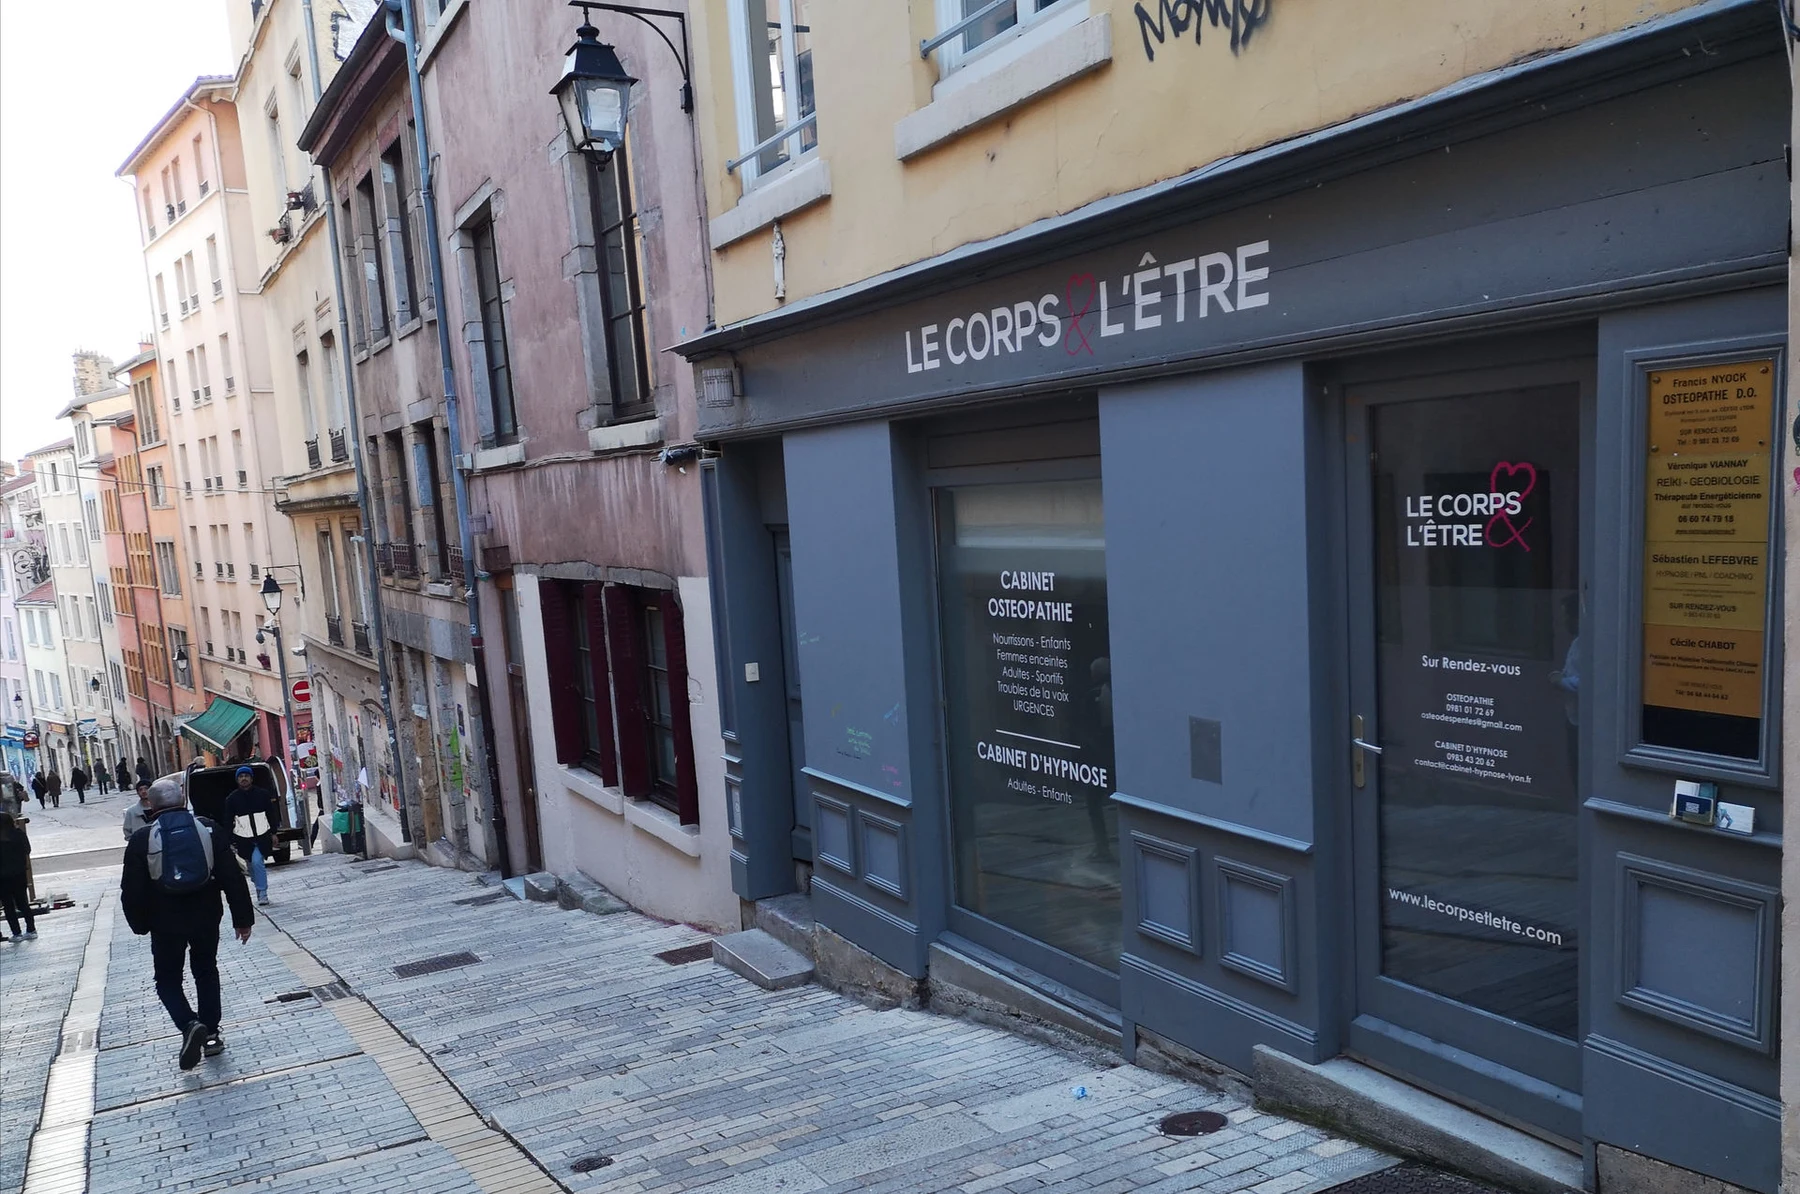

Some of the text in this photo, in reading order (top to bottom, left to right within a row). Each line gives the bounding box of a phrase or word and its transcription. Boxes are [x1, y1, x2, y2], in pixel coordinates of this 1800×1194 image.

[905, 323, 940, 374] LE
[945, 293, 1062, 365] CORPS
[1099, 239, 1270, 339] L'ÊTRE
[1672, 372, 1747, 388] Francis NYOCK
[1663, 387, 1757, 405] OSTEOPATHE D.O.
[1667, 459, 1748, 471] Véronique VIANNAY
[1689, 475, 1760, 487] GEOBIOLOGIE
[1406, 491, 1521, 517] LE CORPS
[1654, 491, 1762, 502] Thérapeute Energéticienne
[1678, 515, 1688, 523] 06
[1700, 515, 1710, 523] 74
[1407, 519, 1483, 546] L'ÊTRE
[1652, 554, 1759, 566] Sébastien LEFEBVRE
[1000, 570, 1055, 591] CABINET
[988, 598, 1073, 622] OSTEOPATHIE
[1669, 602, 1683, 610] SUR
[993, 633, 1034, 647] Nourrissons
[1040, 635, 1071, 650] Enfants
[1670, 637, 1737, 650] Cécile CHABOT
[997, 648, 1068, 669] Femmes enceintes
[1421, 654, 1521, 676] Sur Rendez-vous
[1002, 666, 1030, 681] Adultes
[1035, 670, 1064, 685] Sportifs
[997, 680, 1070, 702] Troubles de la voix
[1446, 693, 1494, 706] OSTEOPATHIE
[1013, 699, 1055, 718] URGENCES
[1446, 703, 1495, 717] 0981 01 72 69
[1434, 740, 1509, 759] CABINET D'HYPNOSE
[977, 741, 1107, 788] CABINET D'HYPNOSE
[1446, 752, 1496, 768] 0983 43 20 62
[1007, 778, 1036, 795] Adultes
[1042, 785, 1073, 804] Enfants
[1389, 888, 1562, 946] www.lecorpsetletre.com
